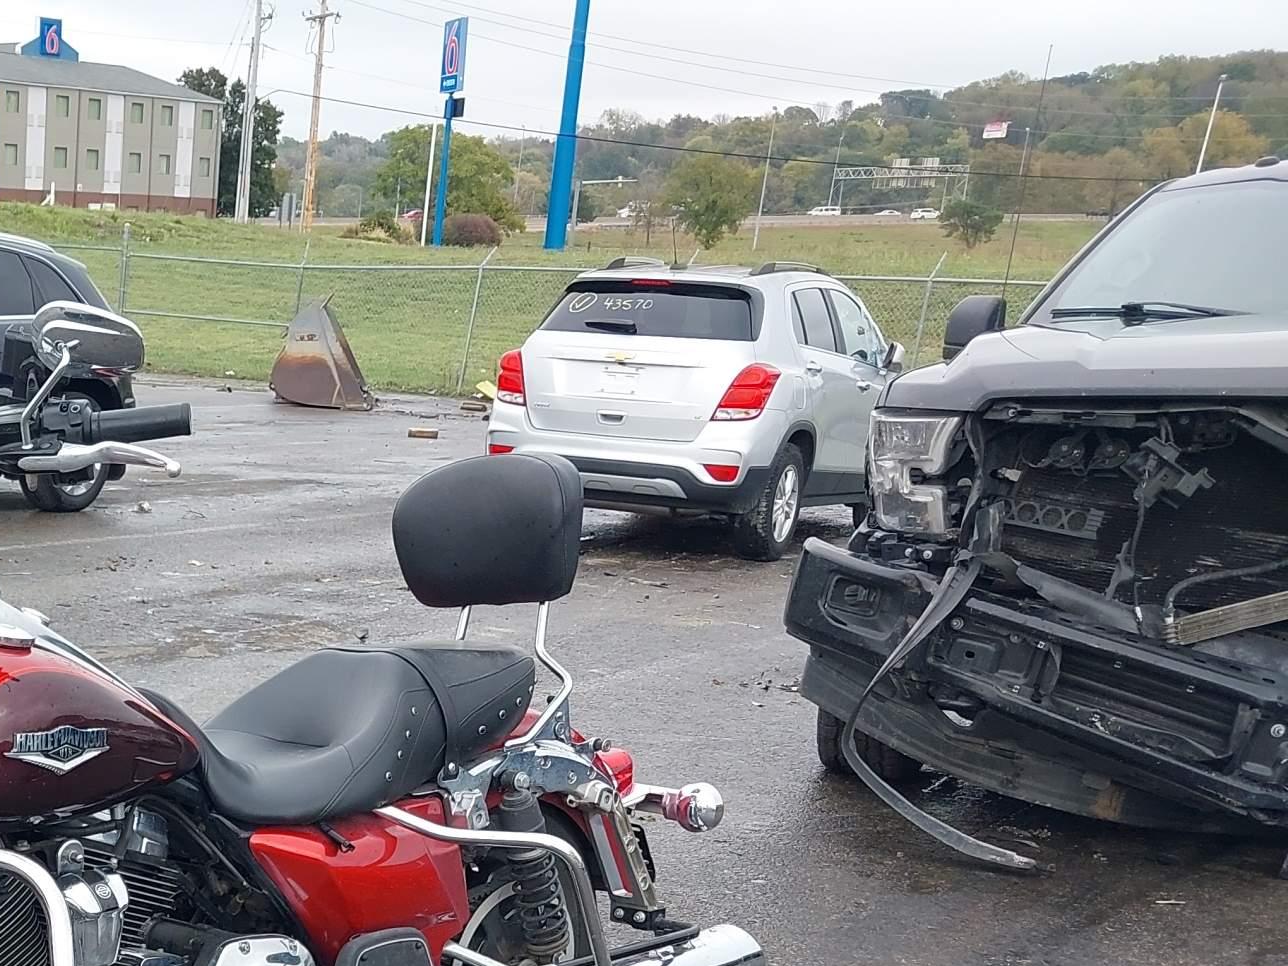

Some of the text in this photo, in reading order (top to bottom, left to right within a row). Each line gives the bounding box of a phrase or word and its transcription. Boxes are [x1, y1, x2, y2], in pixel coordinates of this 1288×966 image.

[46, 24, 59, 54] 6
[445, 20, 458, 75] 6
[604, 297, 654, 311] 43570
